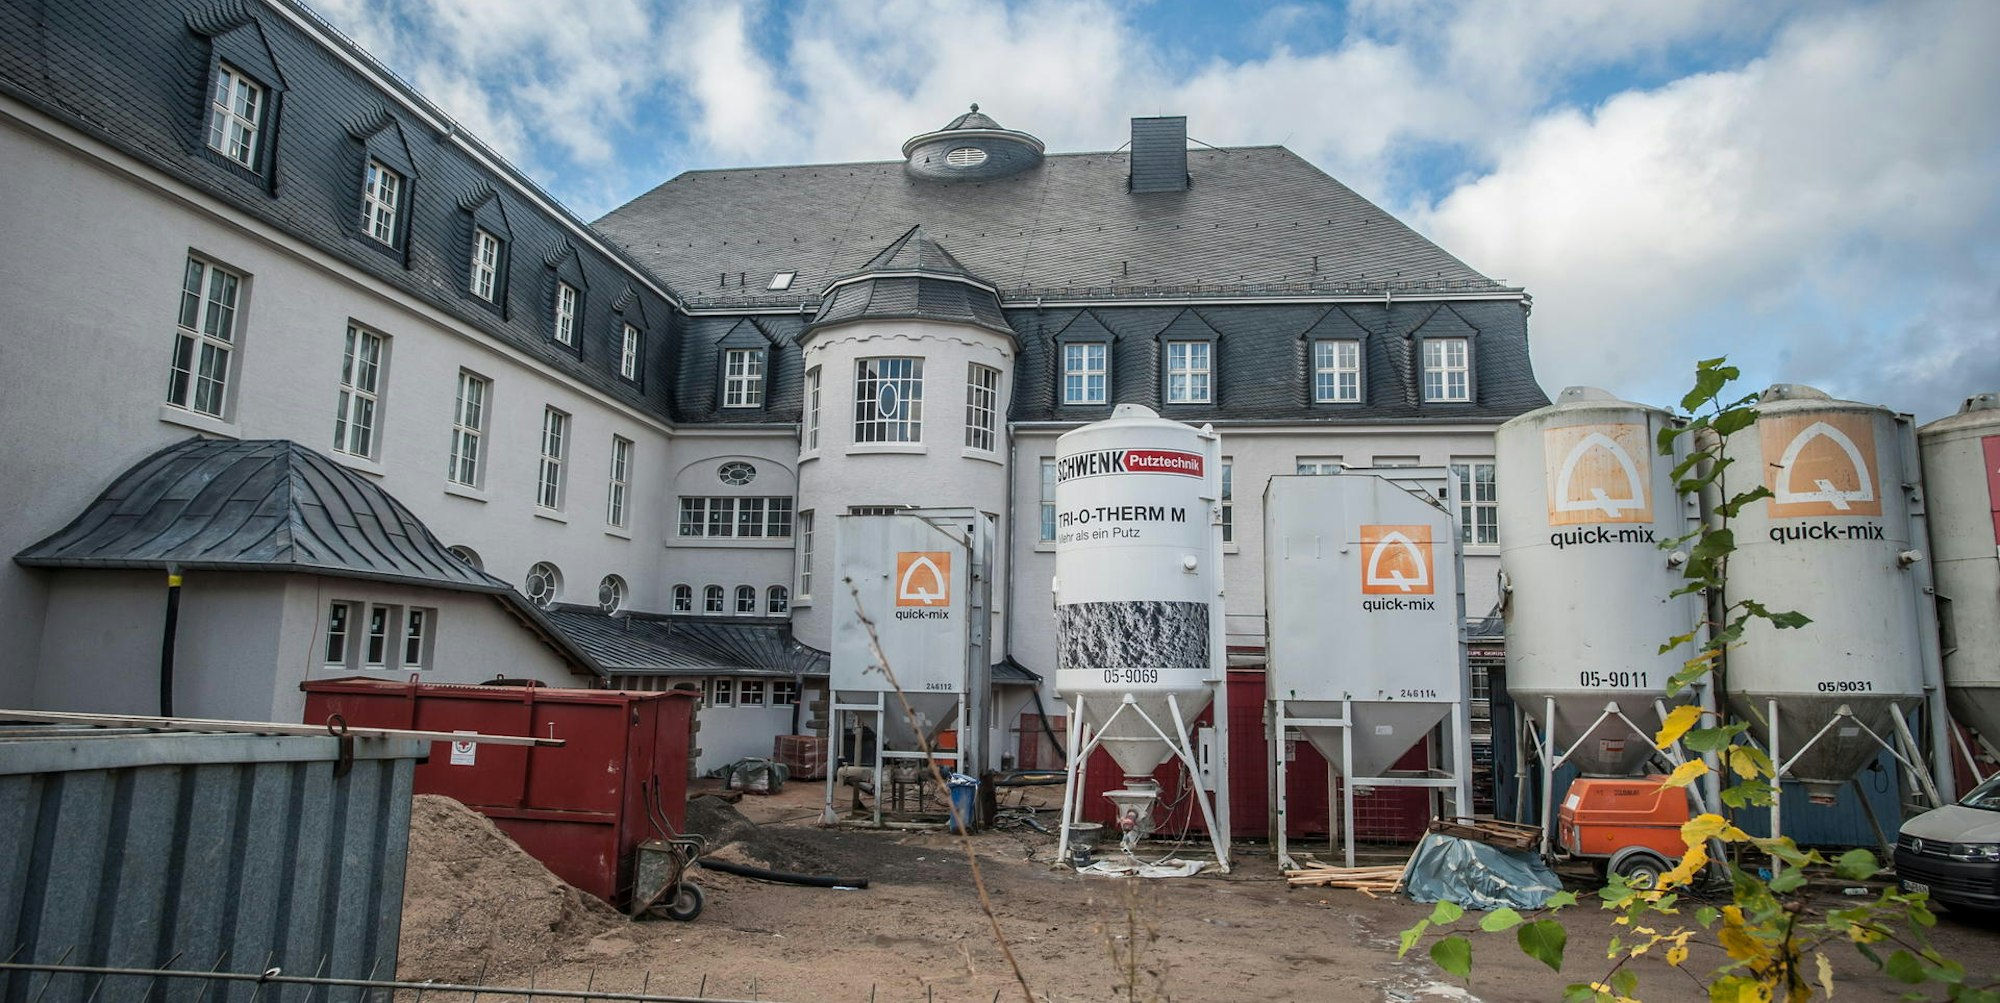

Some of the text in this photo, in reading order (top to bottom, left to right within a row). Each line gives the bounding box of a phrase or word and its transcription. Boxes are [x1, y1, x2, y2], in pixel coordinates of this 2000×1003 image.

[1057, 450, 1200, 483] SCHWENK Putztechnik
[1058, 505, 1186, 529] TRI-O-THERM M
[1075, 529, 1090, 542] als
[1092, 528, 1109, 540] ein
[1112, 526, 1141, 539] Putz
[1550, 525, 1656, 550] quick-mix
[1769, 521, 1884, 545] quick-mix
[1362, 598, 1435, 613] quick-mix
[895, 609, 950, 621] quick-mix
[1103, 669, 1158, 684] 05-9069
[1580, 671, 1647, 688] 05-9011
[926, 683, 952, 691] 246112
[1400, 689, 1436, 698] 246114
[1817, 681, 1873, 692] 05/9031
